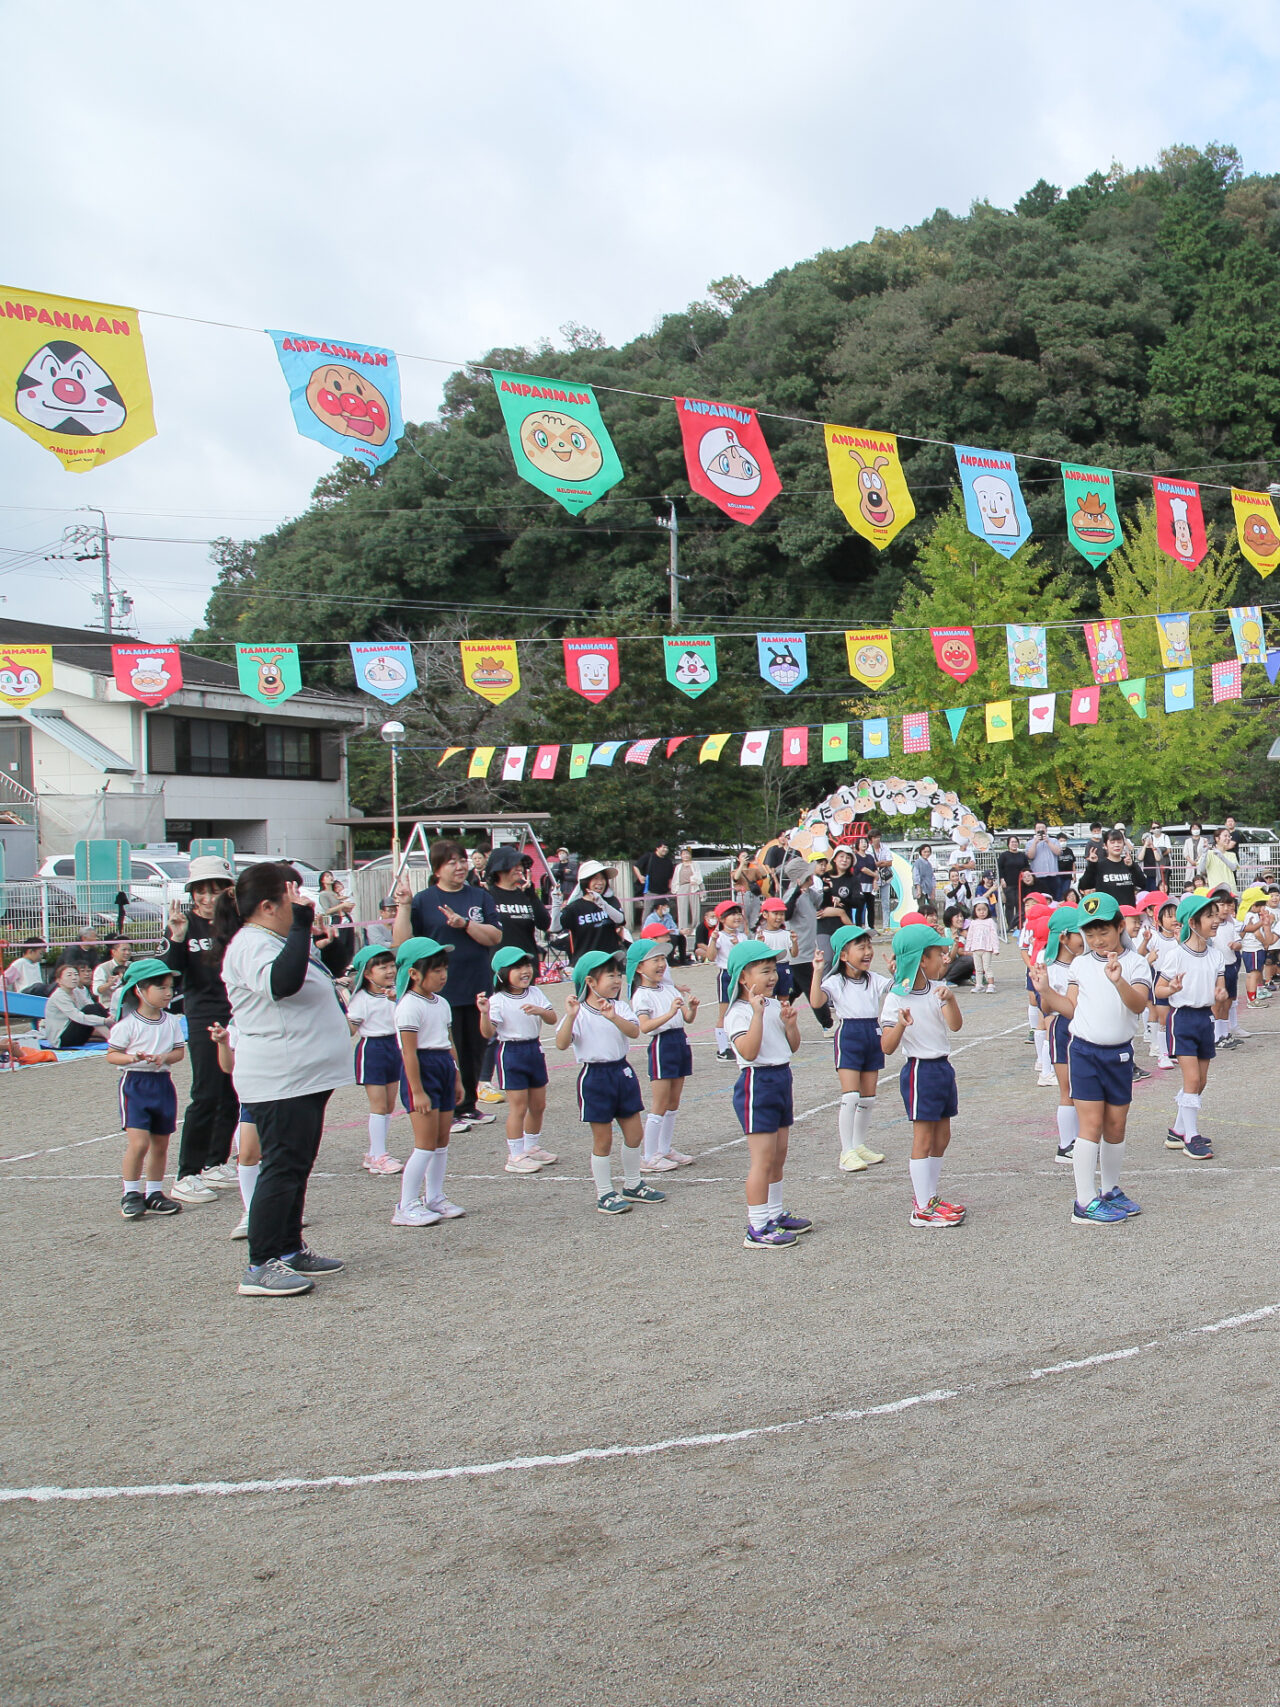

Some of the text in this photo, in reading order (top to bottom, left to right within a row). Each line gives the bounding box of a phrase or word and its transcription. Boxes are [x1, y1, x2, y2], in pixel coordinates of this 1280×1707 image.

[282, 337, 388, 366] ANPANMAN
[500, 380, 591, 404] ANPANMAN
[683, 398, 751, 424] ANPANMAN
[725, 430, 735, 444] R
[831, 433, 896, 454] ANPANMAN
[960, 454, 1012, 471] ANPANMAN
[1065, 470, 1110, 485] ANPANMAN
[1157, 482, 1197, 497] ANPANMAN
